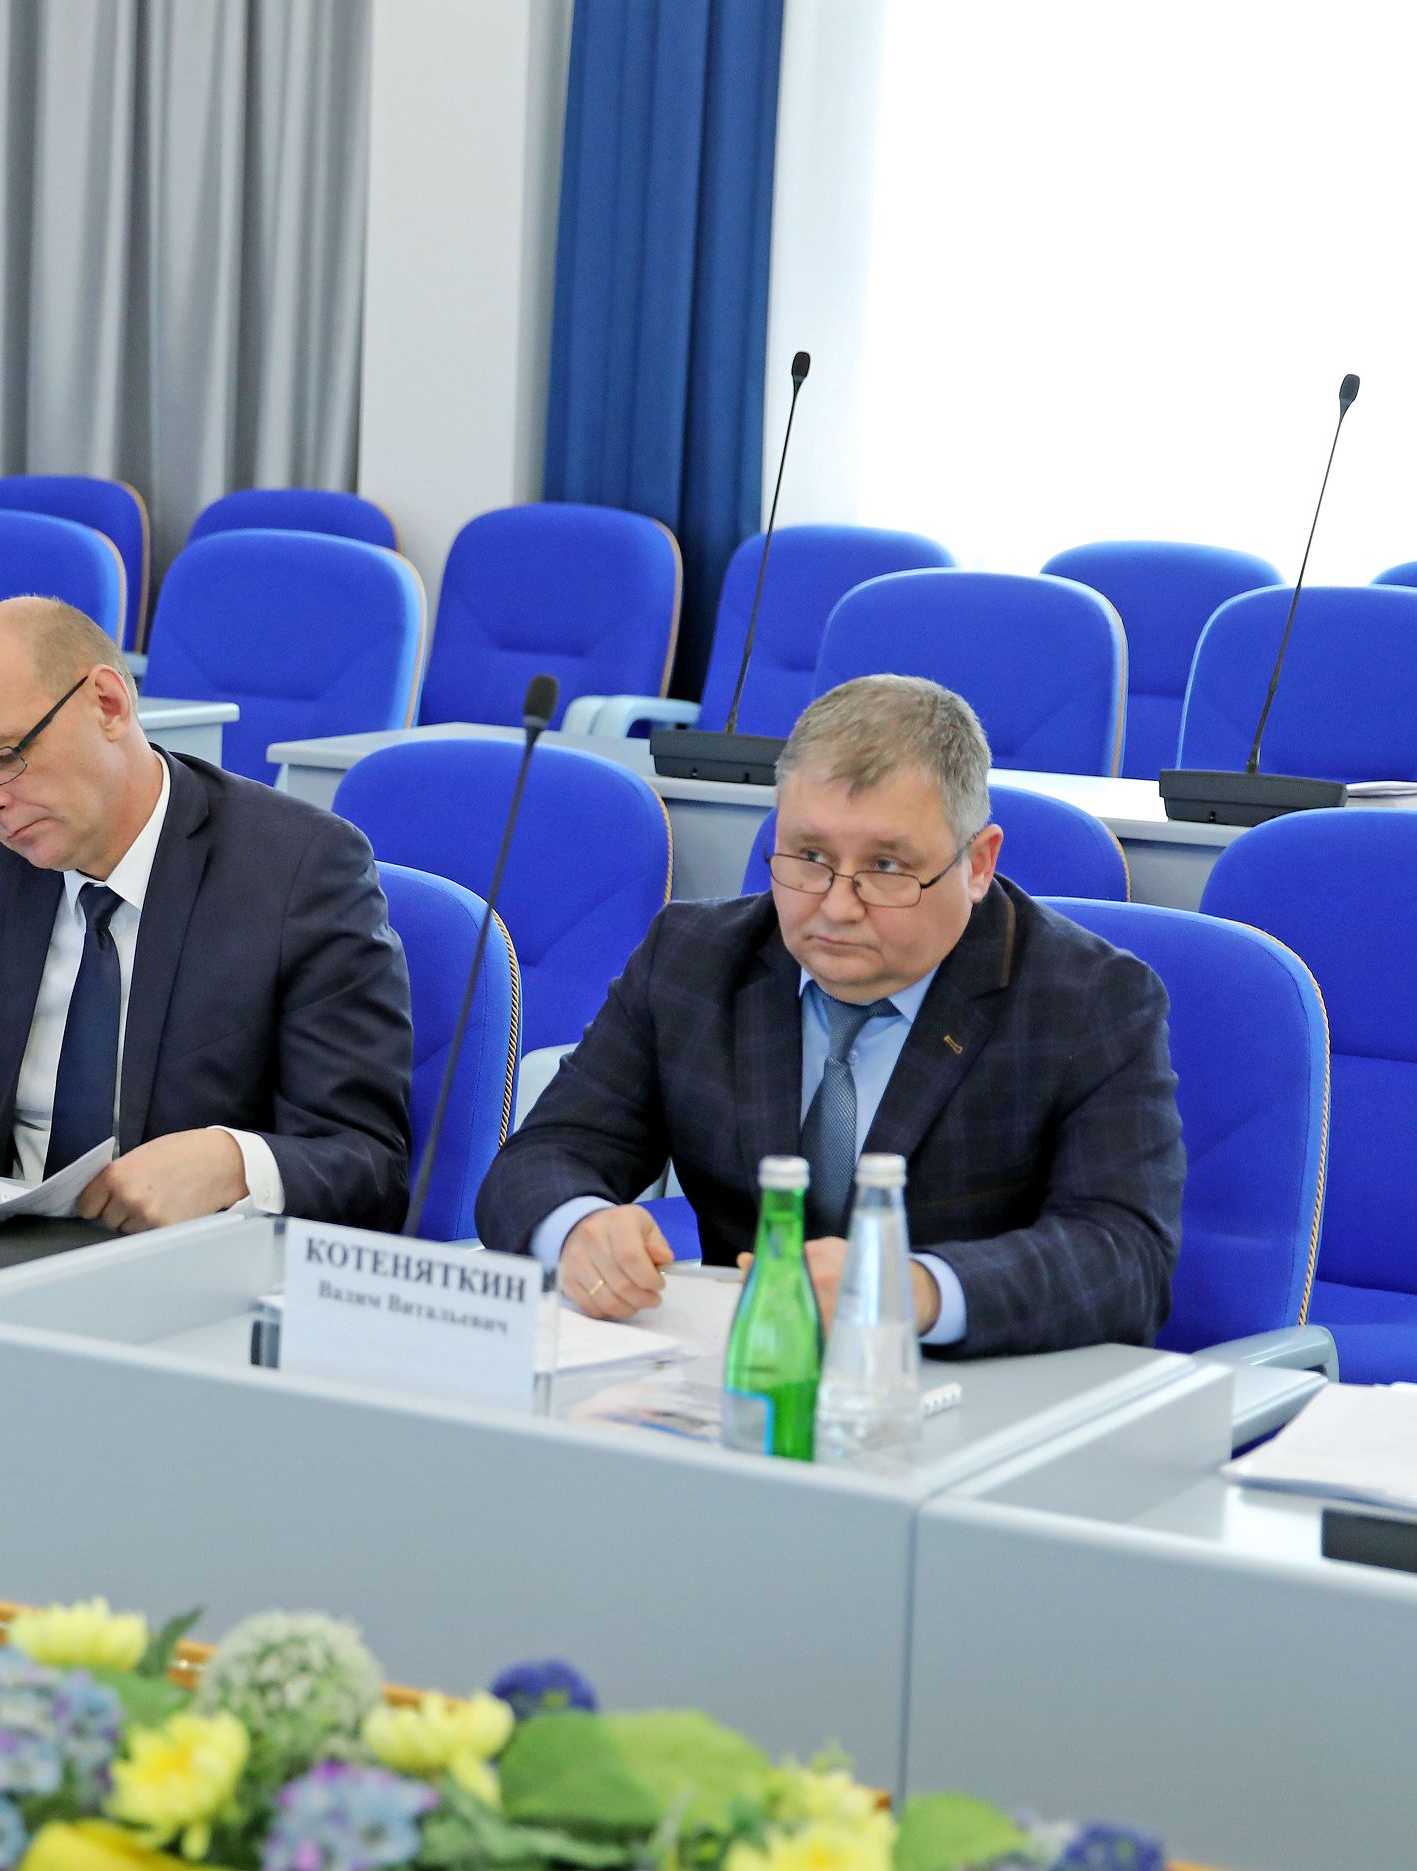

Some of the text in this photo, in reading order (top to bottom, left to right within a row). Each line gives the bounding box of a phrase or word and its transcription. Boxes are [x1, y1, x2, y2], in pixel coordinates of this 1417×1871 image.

[304, 1236, 528, 1304] КОТЕНЯТКИН
[317, 1280, 509, 1336] Вадим Витальевич
